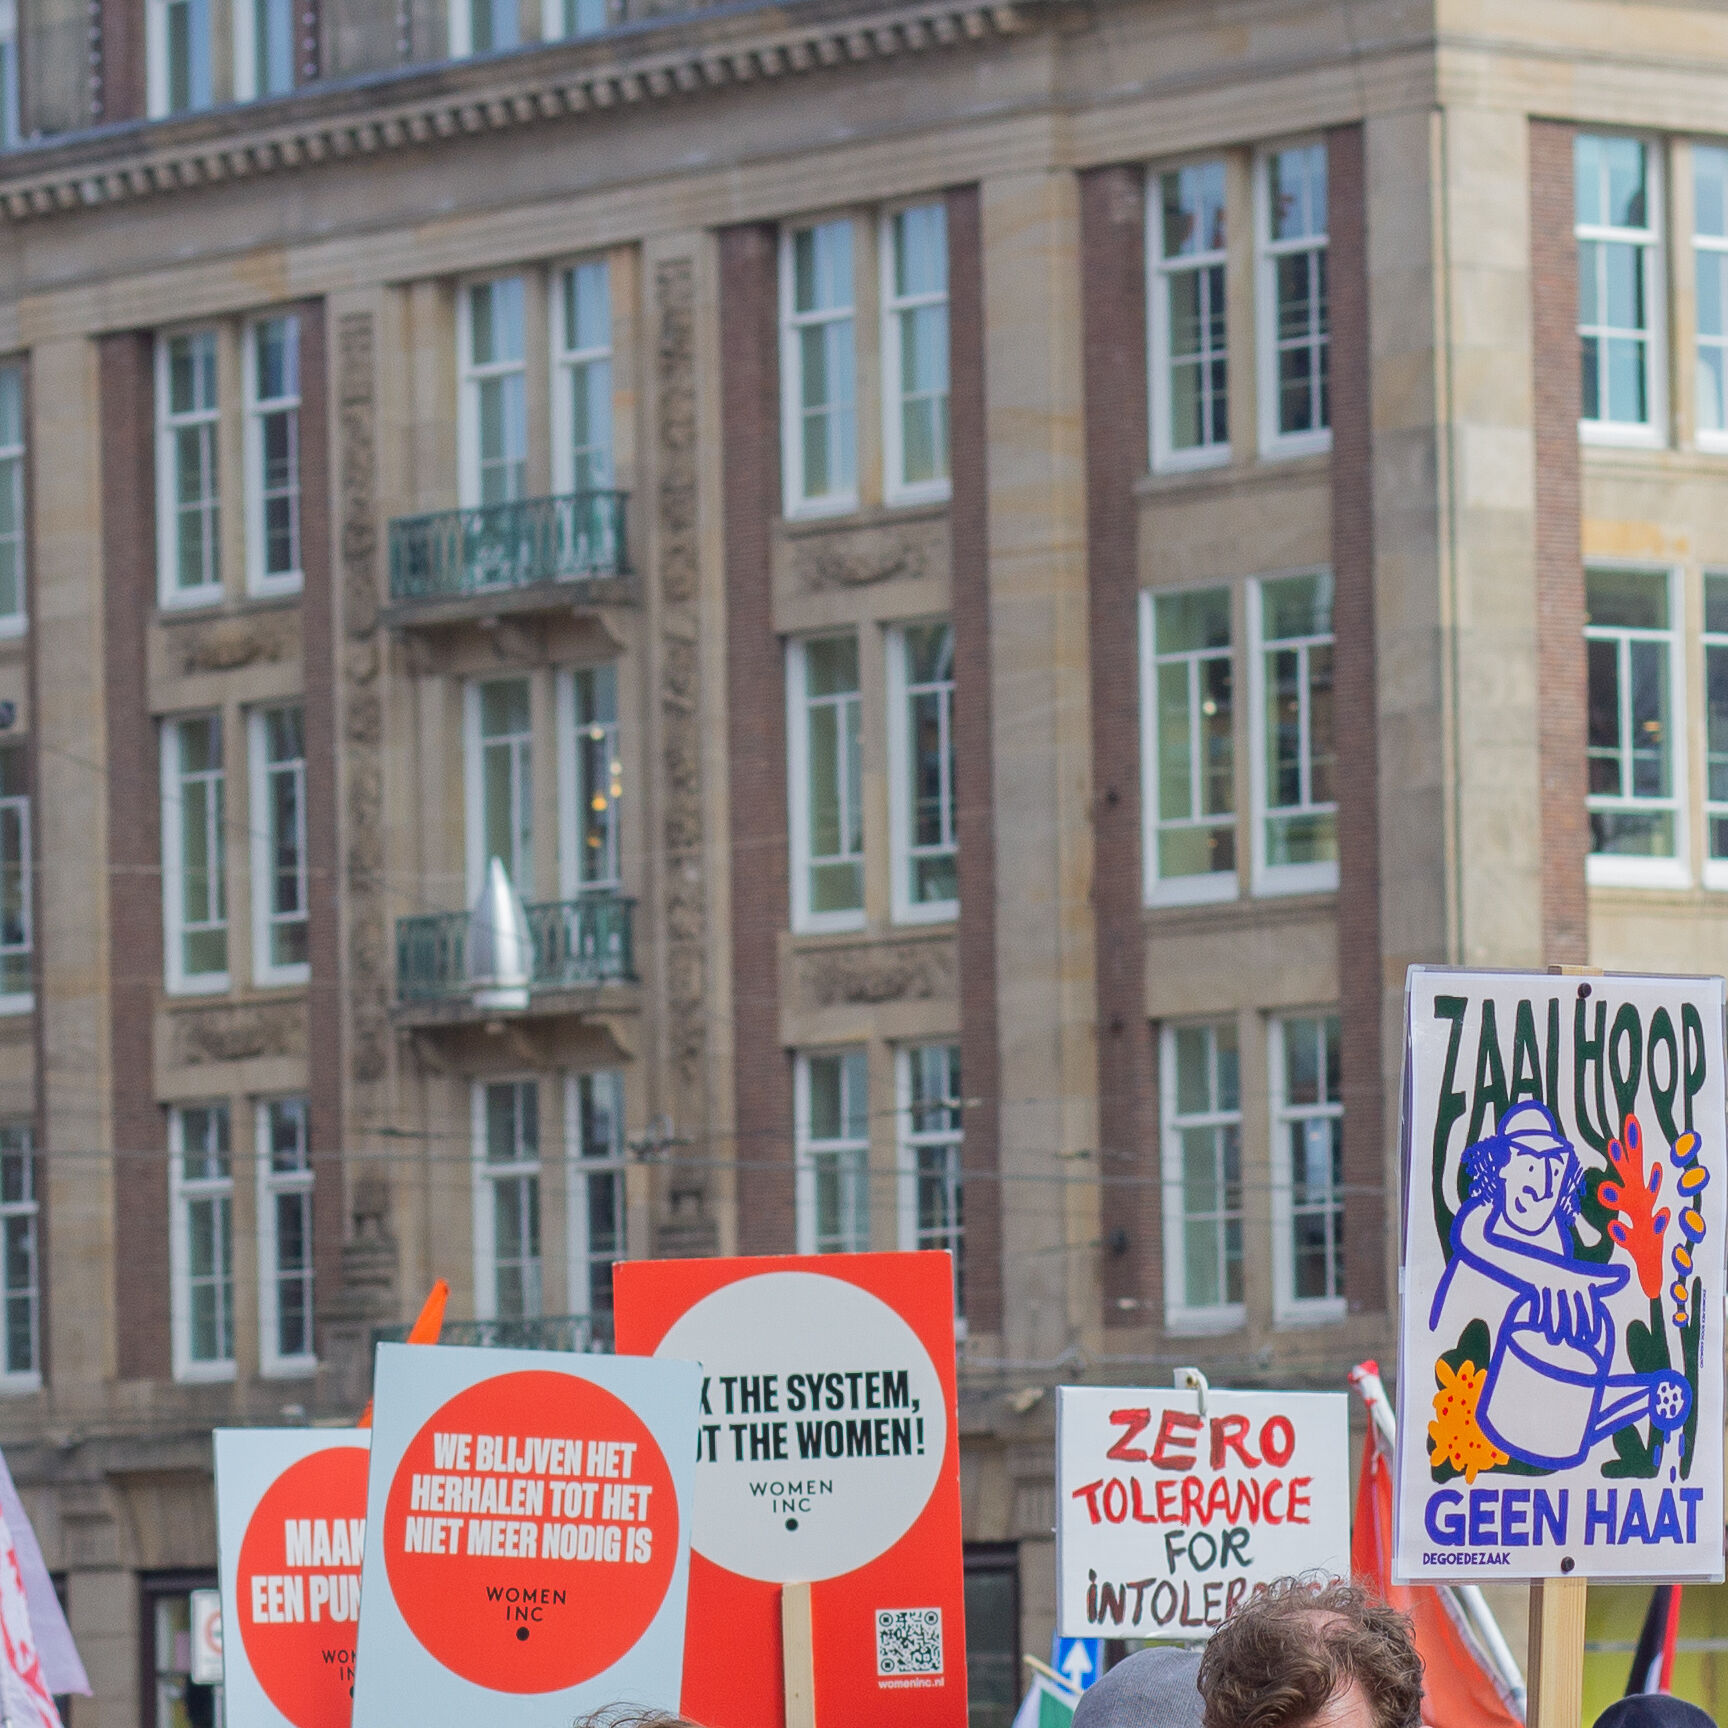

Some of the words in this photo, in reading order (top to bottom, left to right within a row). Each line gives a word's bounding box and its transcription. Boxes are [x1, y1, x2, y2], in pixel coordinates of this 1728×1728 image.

[1573, 998, 1706, 1150] HOOP
[719, 1375, 779, 1415] THE
[786, 1370, 921, 1414] SYSTEM,
[433, 1432, 473, 1471] WE
[475, 1434, 583, 1476] BLIJVEN
[585, 1440, 638, 1479] HET
[729, 1422, 789, 1462] THE
[796, 1417, 925, 1460] WOMEN!
[1106, 1407, 1296, 1472] ZERO
[410, 1474, 546, 1517] HERHALEN
[549, 1480, 599, 1519] TOT
[601, 1484, 653, 1522] HET
[749, 1480, 834, 1496] WOMEN
[772, 1498, 812, 1513] INC
[1071, 1475, 1314, 1527] TOLERANCE
[404, 1516, 464, 1555] NIET
[467, 1519, 538, 1559] MEER
[541, 1523, 622, 1563] NODIG
[625, 1527, 653, 1564] IS
[1424, 1488, 1569, 1547] GEEN
[1583, 1487, 1704, 1546] HAAT
[1164, 1527, 1254, 1575] FOR
[1422, 1552, 1511, 1566] DEGOEDEZAAK
[251, 1575, 305, 1624] EEN
[486, 1587, 567, 1605] WOMEN
[506, 1606, 544, 1622] INC
